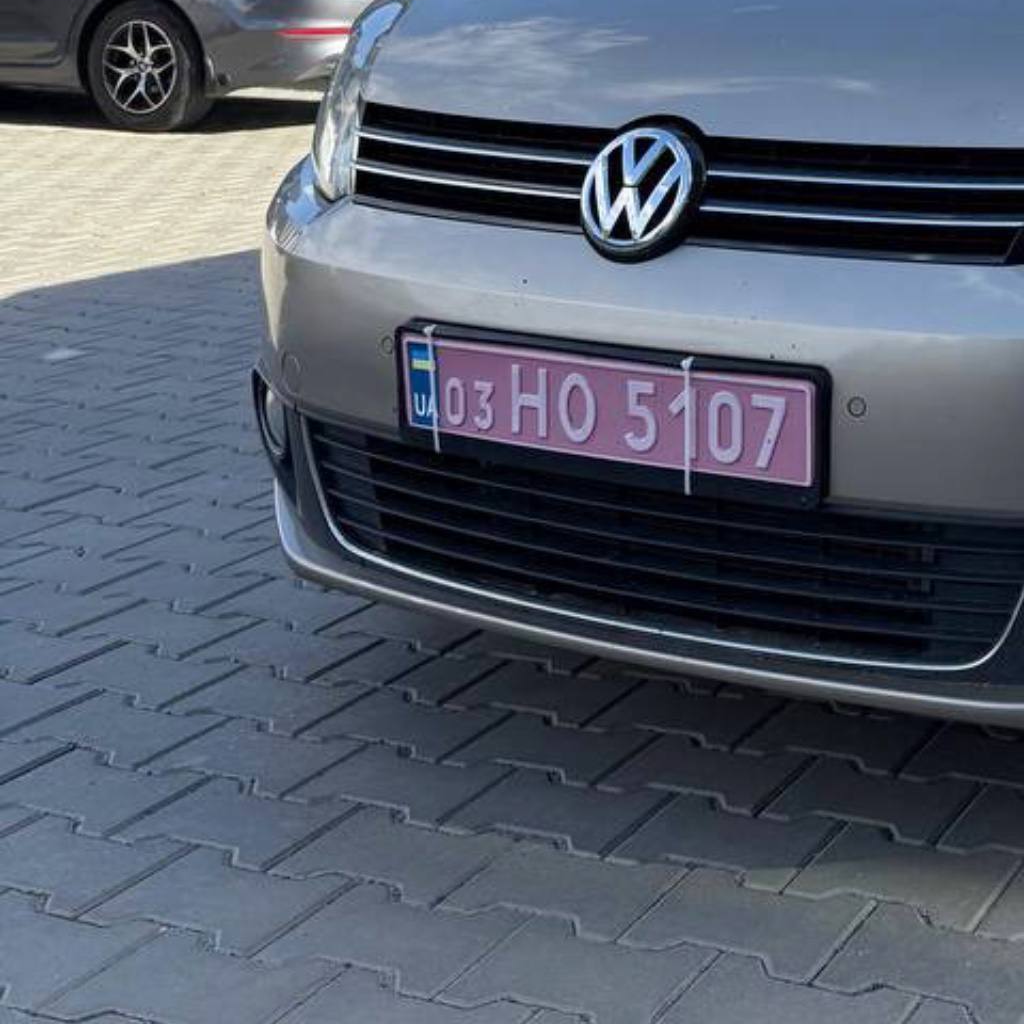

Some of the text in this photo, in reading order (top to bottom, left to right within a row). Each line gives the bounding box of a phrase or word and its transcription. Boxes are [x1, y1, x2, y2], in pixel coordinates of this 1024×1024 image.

[581, 128, 693, 245] VW
[445, 364, 786, 469] 03 HO 5107
